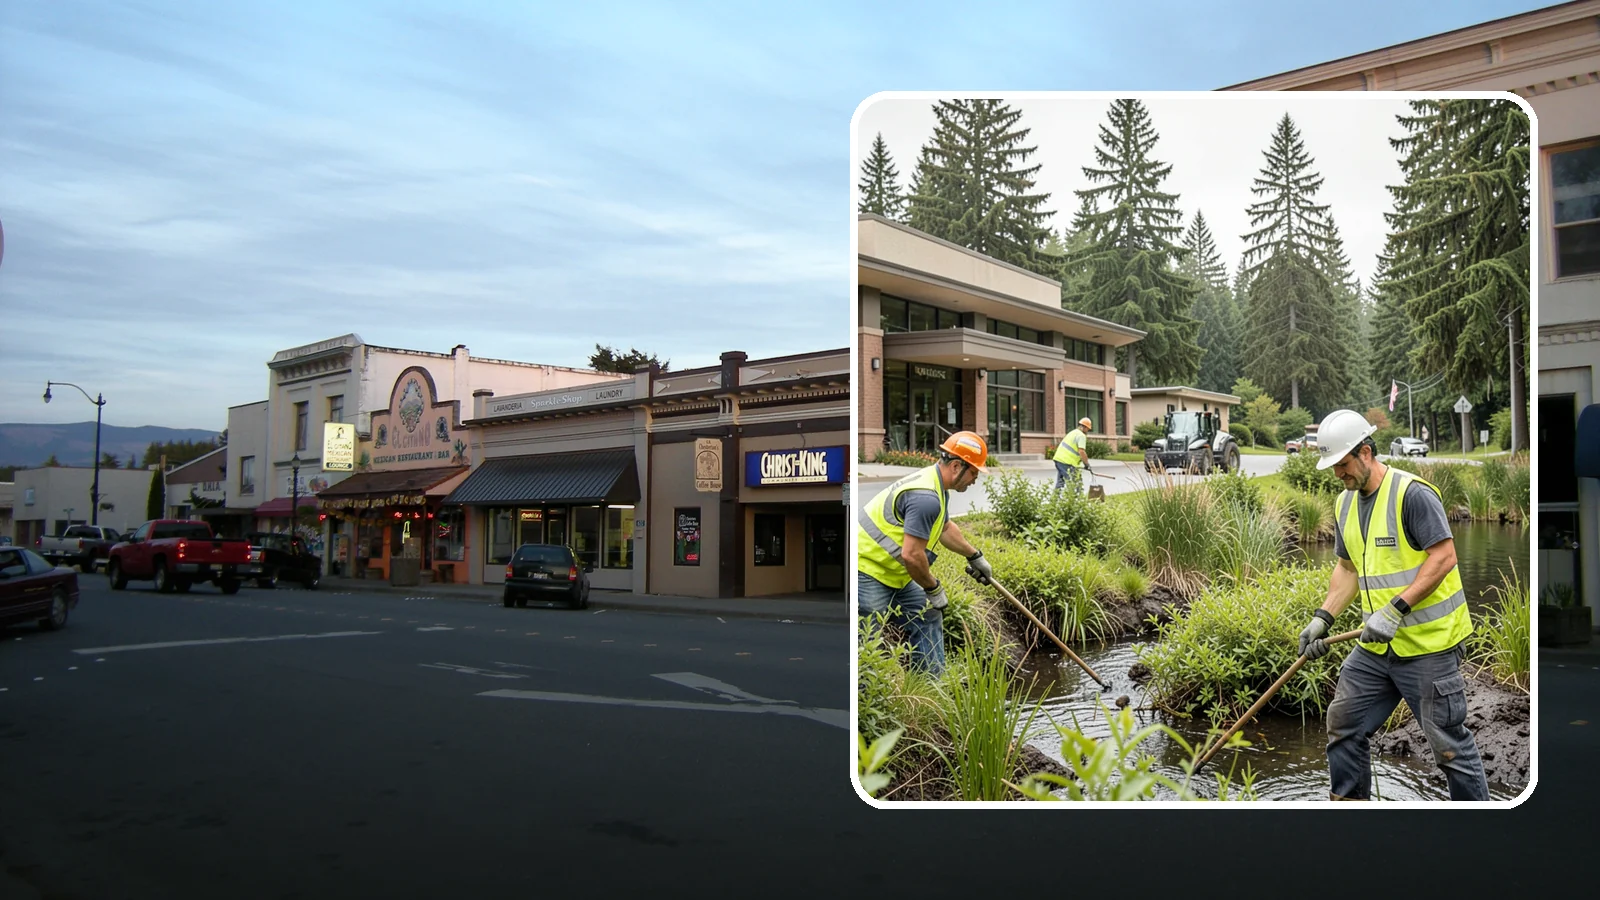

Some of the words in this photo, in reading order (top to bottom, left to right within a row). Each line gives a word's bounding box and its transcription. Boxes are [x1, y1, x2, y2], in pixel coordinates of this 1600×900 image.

[595, 389, 623, 400] LAUNDRY
[493, 402, 522, 413] LAVANDERIA
[530, 396, 560, 409] Sparkle
[561, 394, 582, 405] Shop
[373, 454, 397, 464] MEXICAN
[397, 451, 434, 463] RESTAURANT
[437, 450, 450, 459] BAR
[761, 452, 797, 478] CHRIST
[799, 450, 827, 476] KING
[696, 480, 709, 489] Coffee
